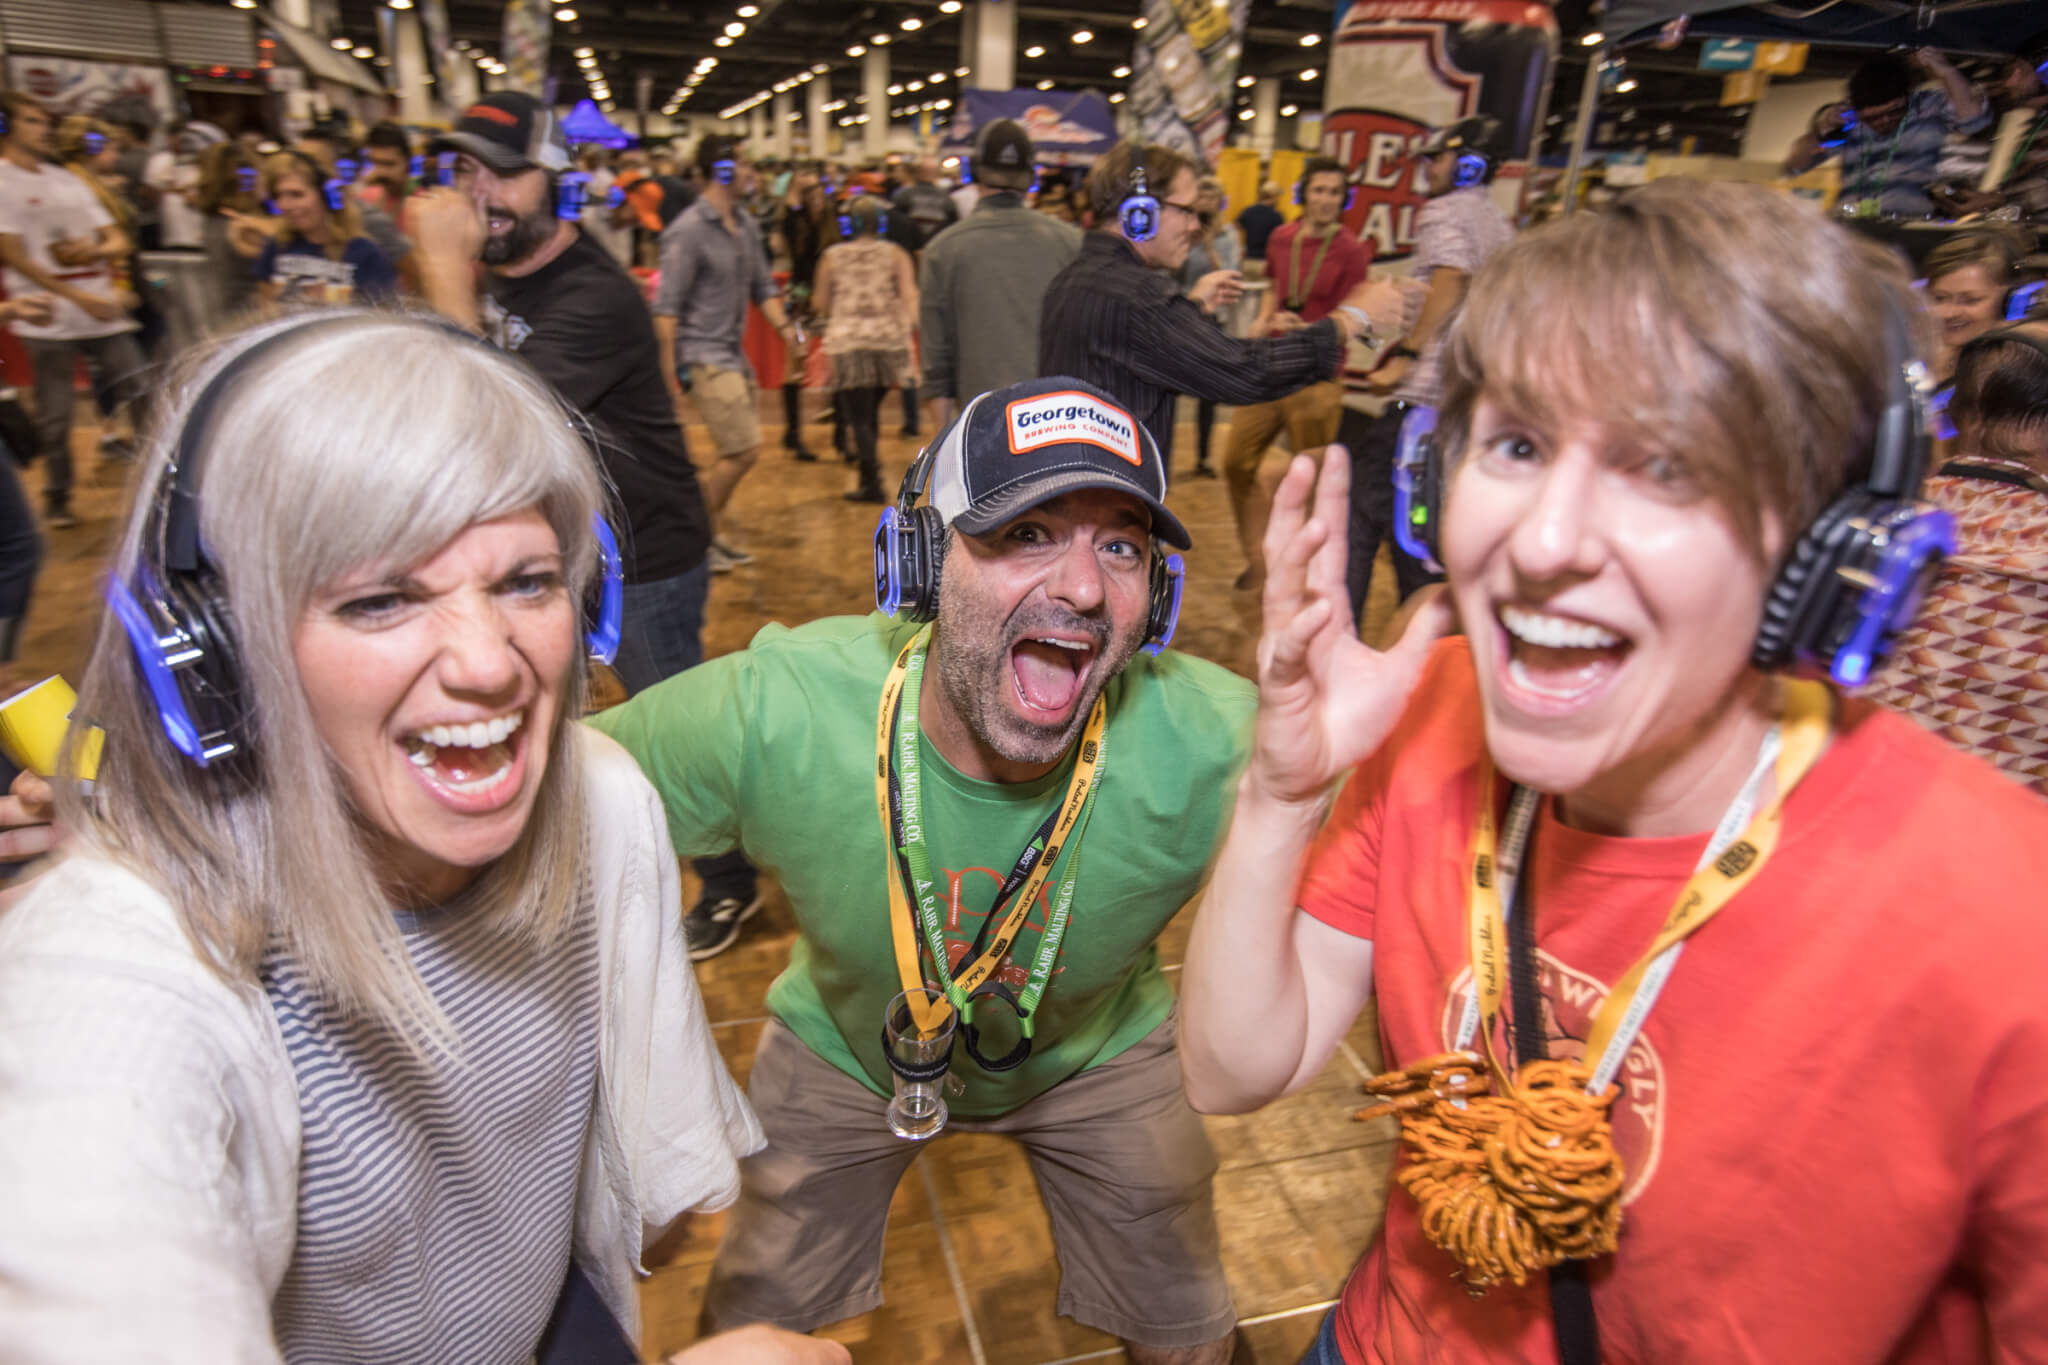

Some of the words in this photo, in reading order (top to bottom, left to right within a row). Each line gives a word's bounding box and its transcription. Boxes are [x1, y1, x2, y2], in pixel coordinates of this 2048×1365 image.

[1359, 202, 1419, 255] AL
[1017, 406, 1131, 438] Georgetown
[1024, 423, 1076, 441] BREWING
[1082, 423, 1128, 448] COMPANY
[902, 732, 916, 769] RAHR
[903, 772, 918, 824] MALTING
[1020, 846, 1037, 866] BSG
[922, 895, 938, 932] RAHR
[930, 929, 949, 976] MALTING
[1033, 946, 1056, 979] RAHR
[1045, 899, 1071, 945] MALTING
